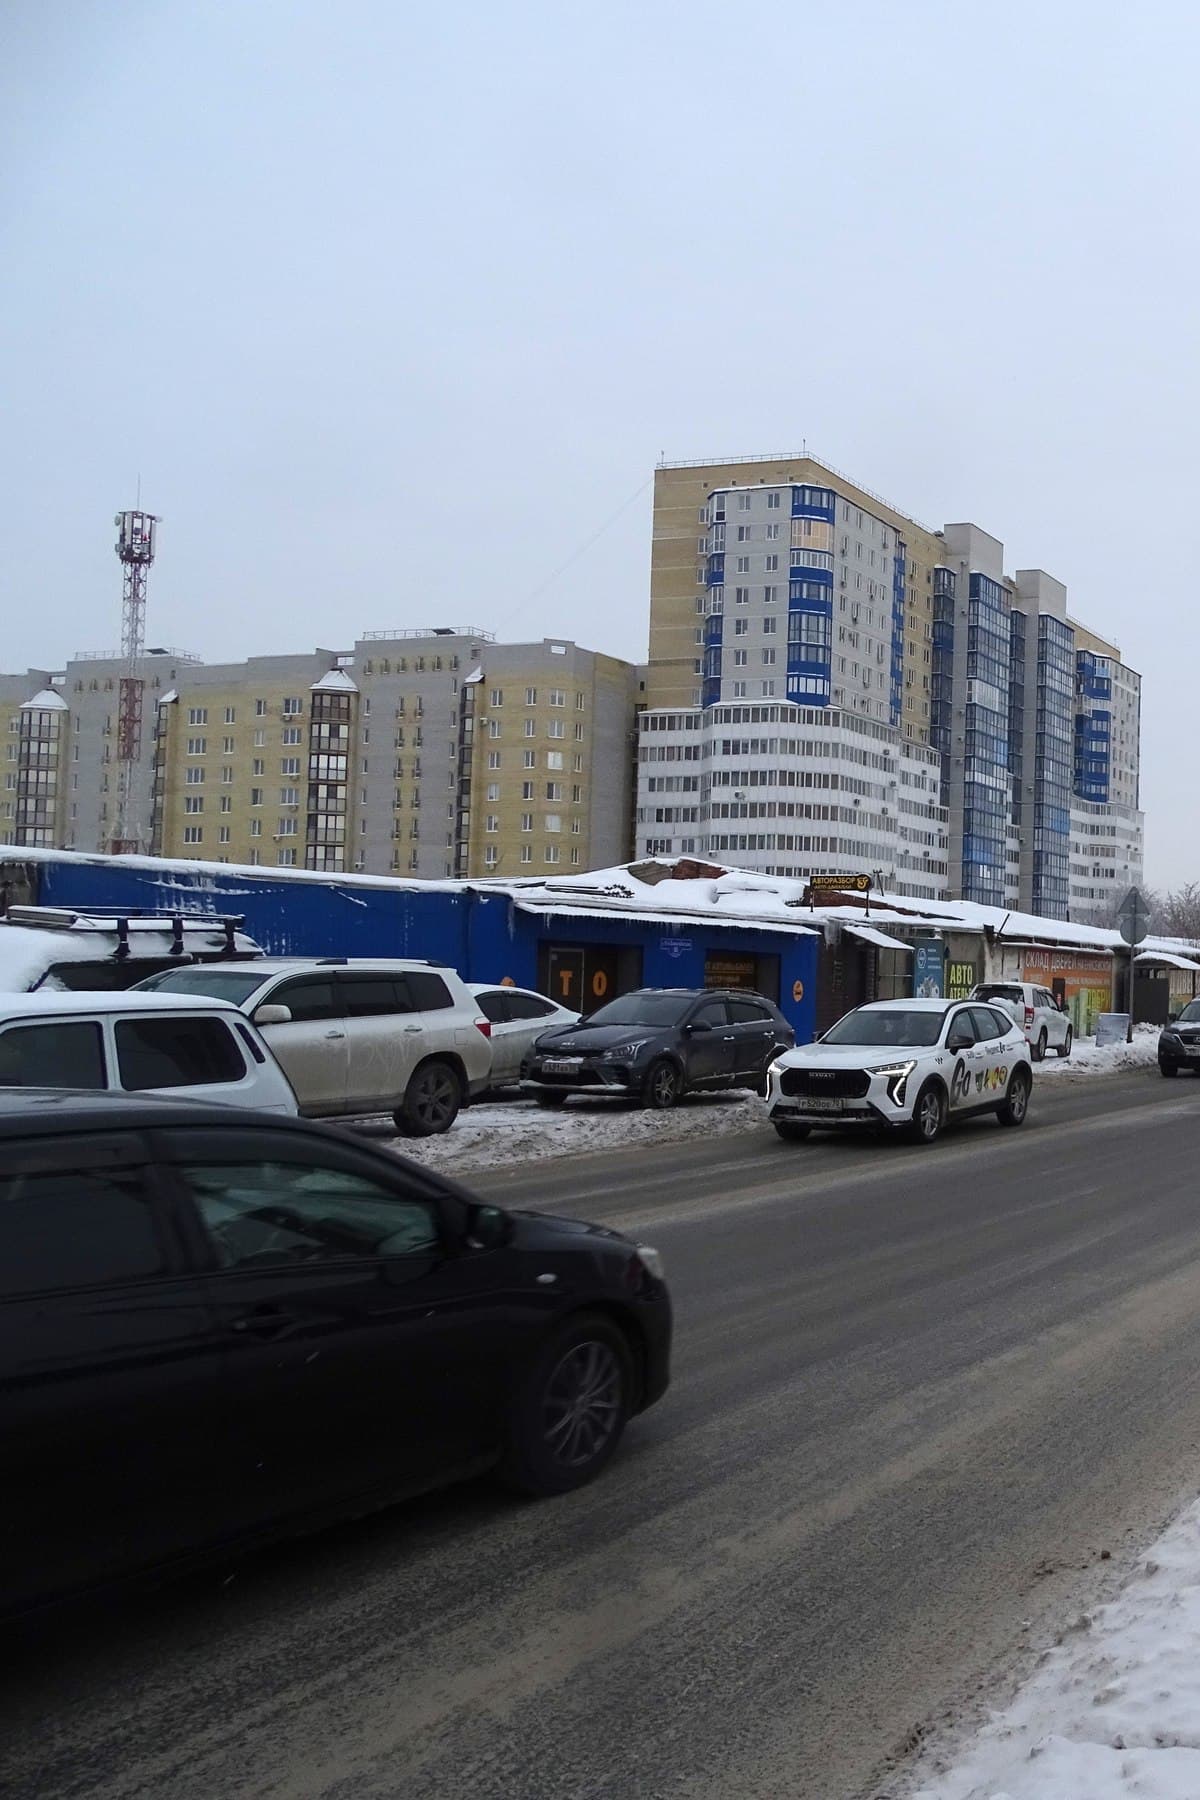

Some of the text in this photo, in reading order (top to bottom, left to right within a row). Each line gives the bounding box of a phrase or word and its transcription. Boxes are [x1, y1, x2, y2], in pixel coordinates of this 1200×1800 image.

[812, 877, 856, 885] АВТОРАЗБОР
[1025, 951, 1049, 972] СКЛАД
[950, 964, 973, 985] АВТО
